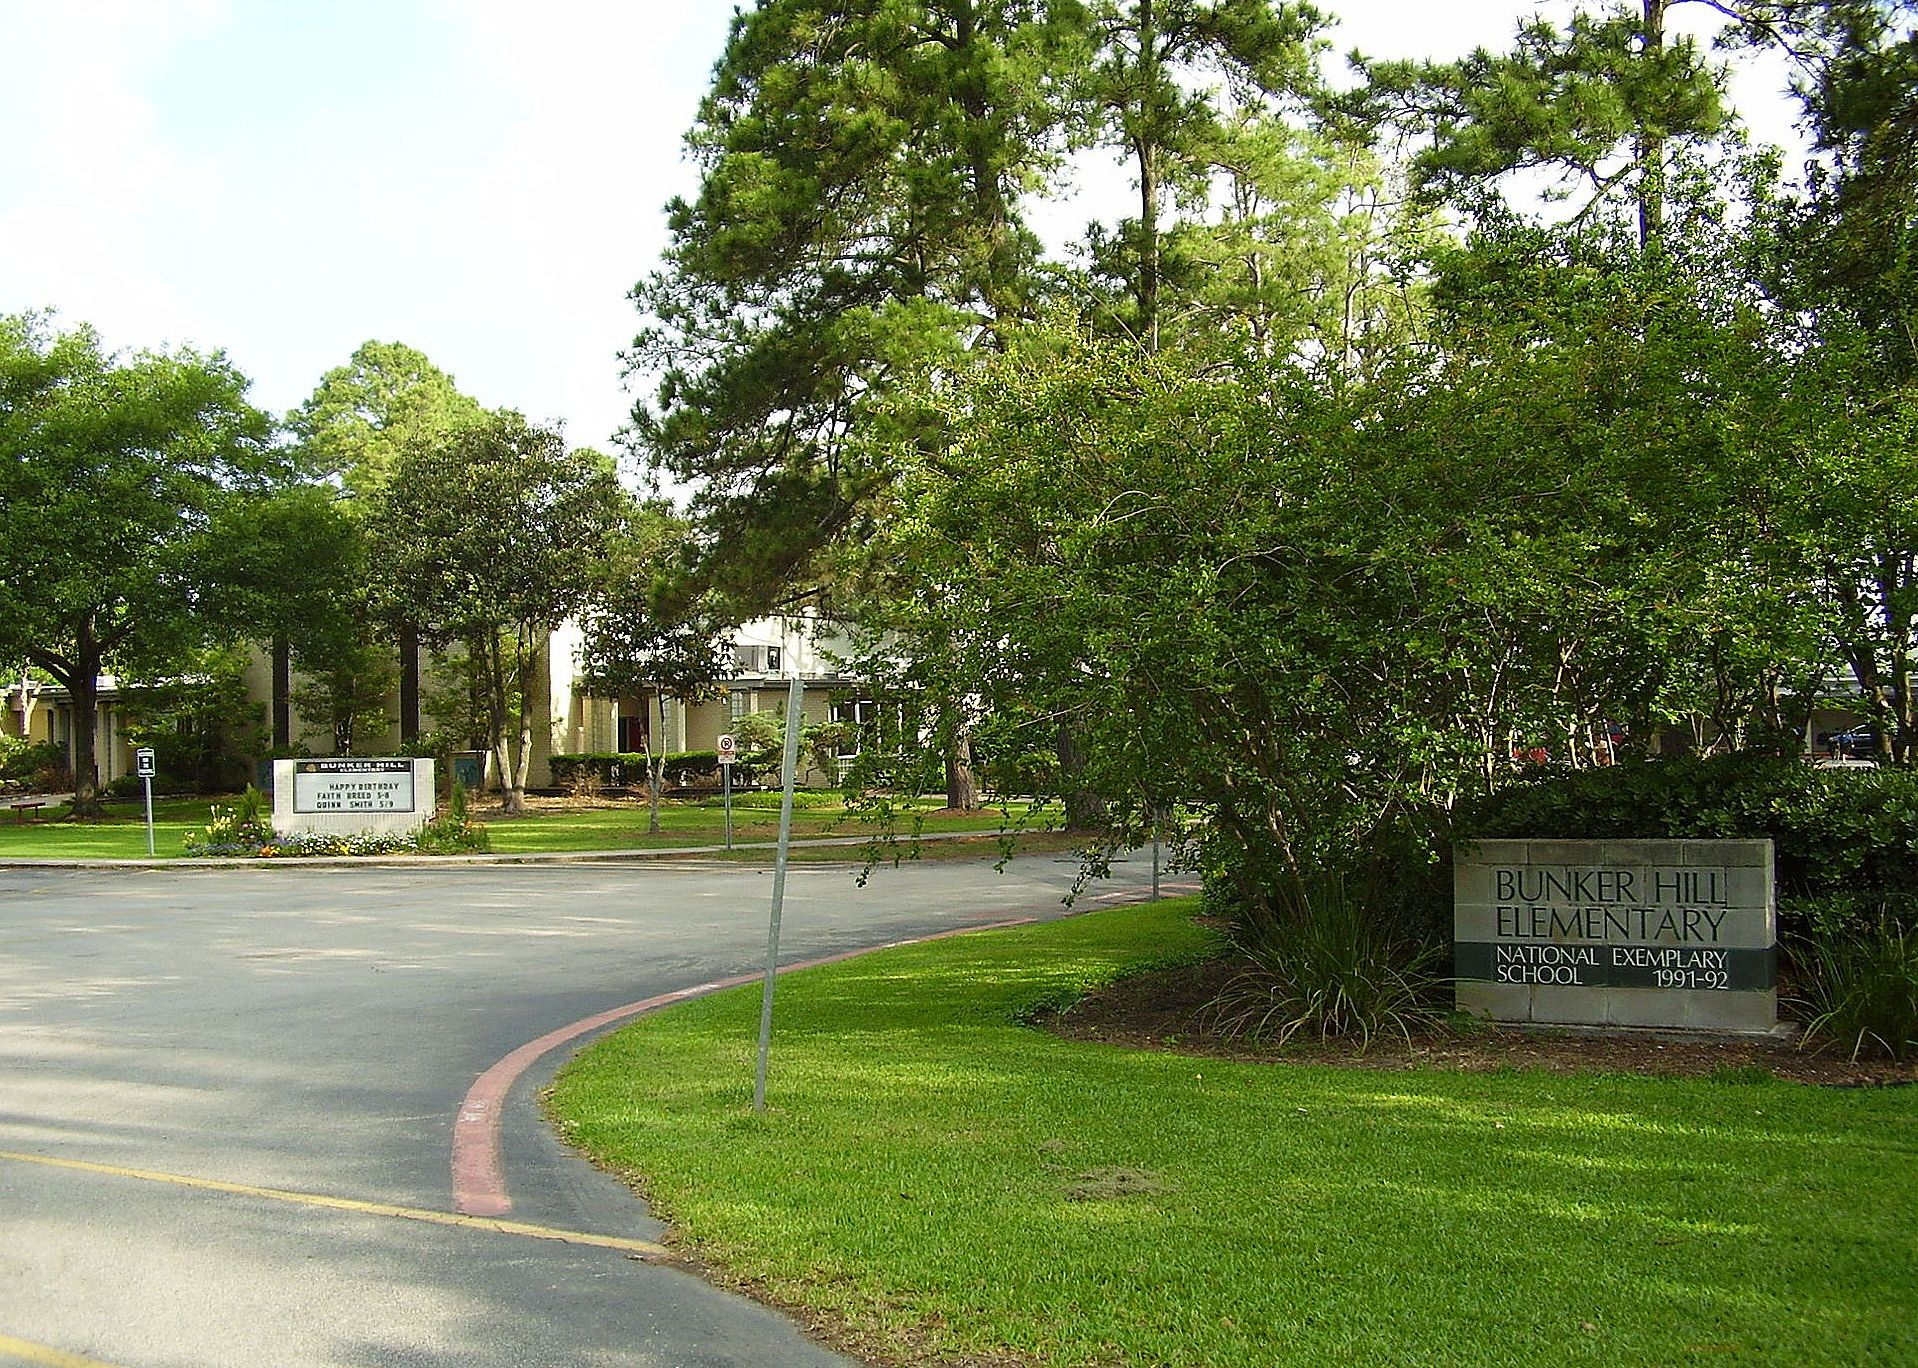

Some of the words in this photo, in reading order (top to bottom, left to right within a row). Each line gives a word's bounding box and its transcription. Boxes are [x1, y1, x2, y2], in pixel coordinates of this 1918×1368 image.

[317, 792, 341, 800] FAITH
[346, 792, 372, 800] BREED
[1496, 870, 1635, 902] BUNKER
[1655, 871, 1726, 905] HILL
[1497, 907, 1726, 941] ELEMENTARY
[1496, 945, 1600, 967] NATIONAL
[1612, 947, 1728, 970] EXEMPLARY
[1497, 964, 1583, 986] SCHOOL
[1652, 968, 1729, 990] 1991-92
